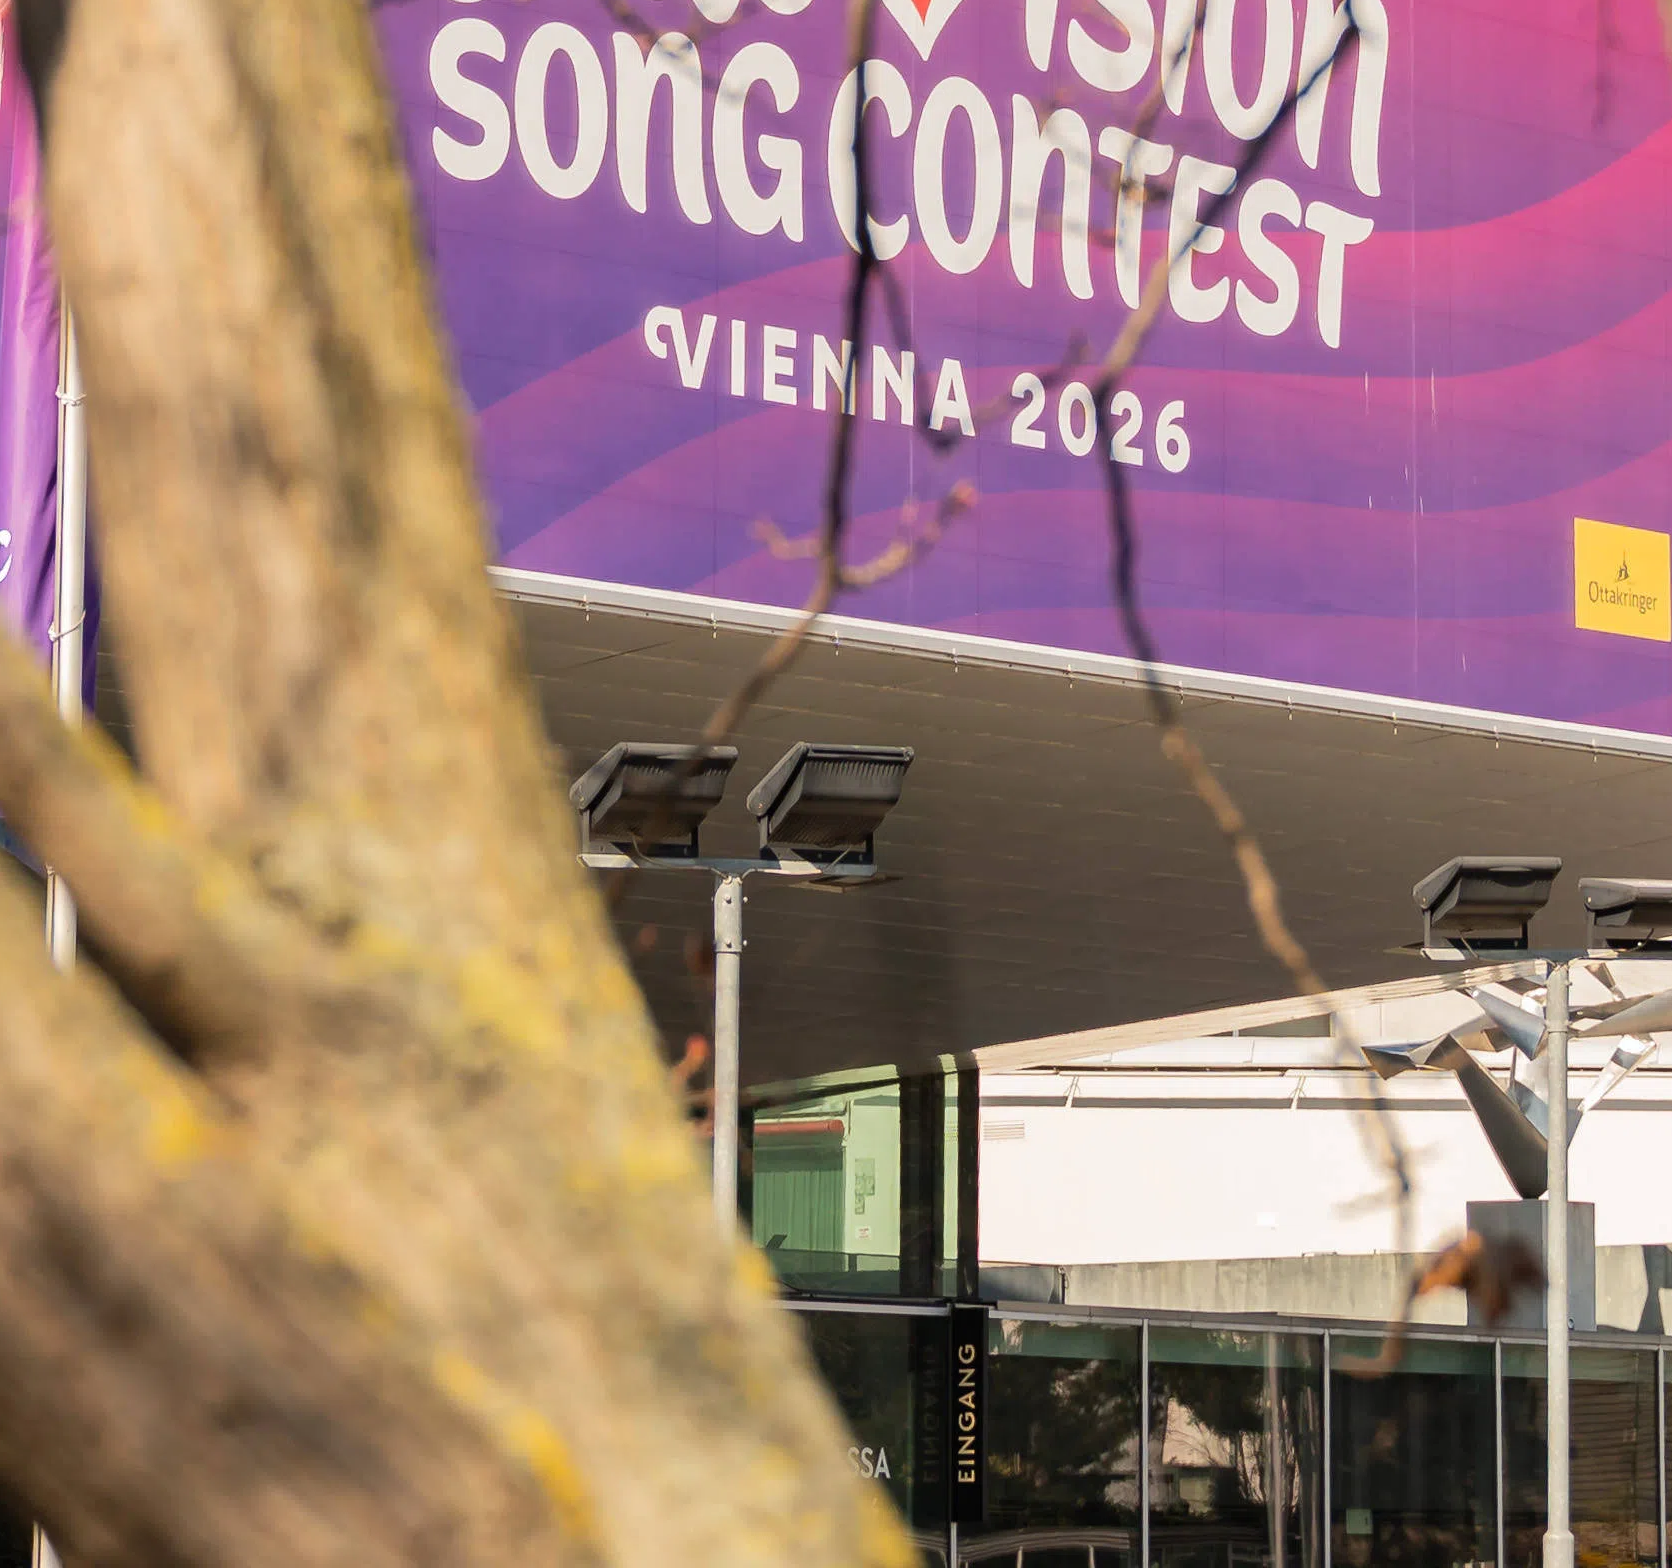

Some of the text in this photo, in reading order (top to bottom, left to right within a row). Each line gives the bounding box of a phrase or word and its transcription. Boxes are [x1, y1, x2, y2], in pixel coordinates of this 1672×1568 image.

[644, 306, 1191, 473] VIENNA 2026
[1588, 581, 1657, 615] Ottakringer
[958, 1344, 976, 1483] EINGANG
[846, 1446, 891, 1480] SSA
